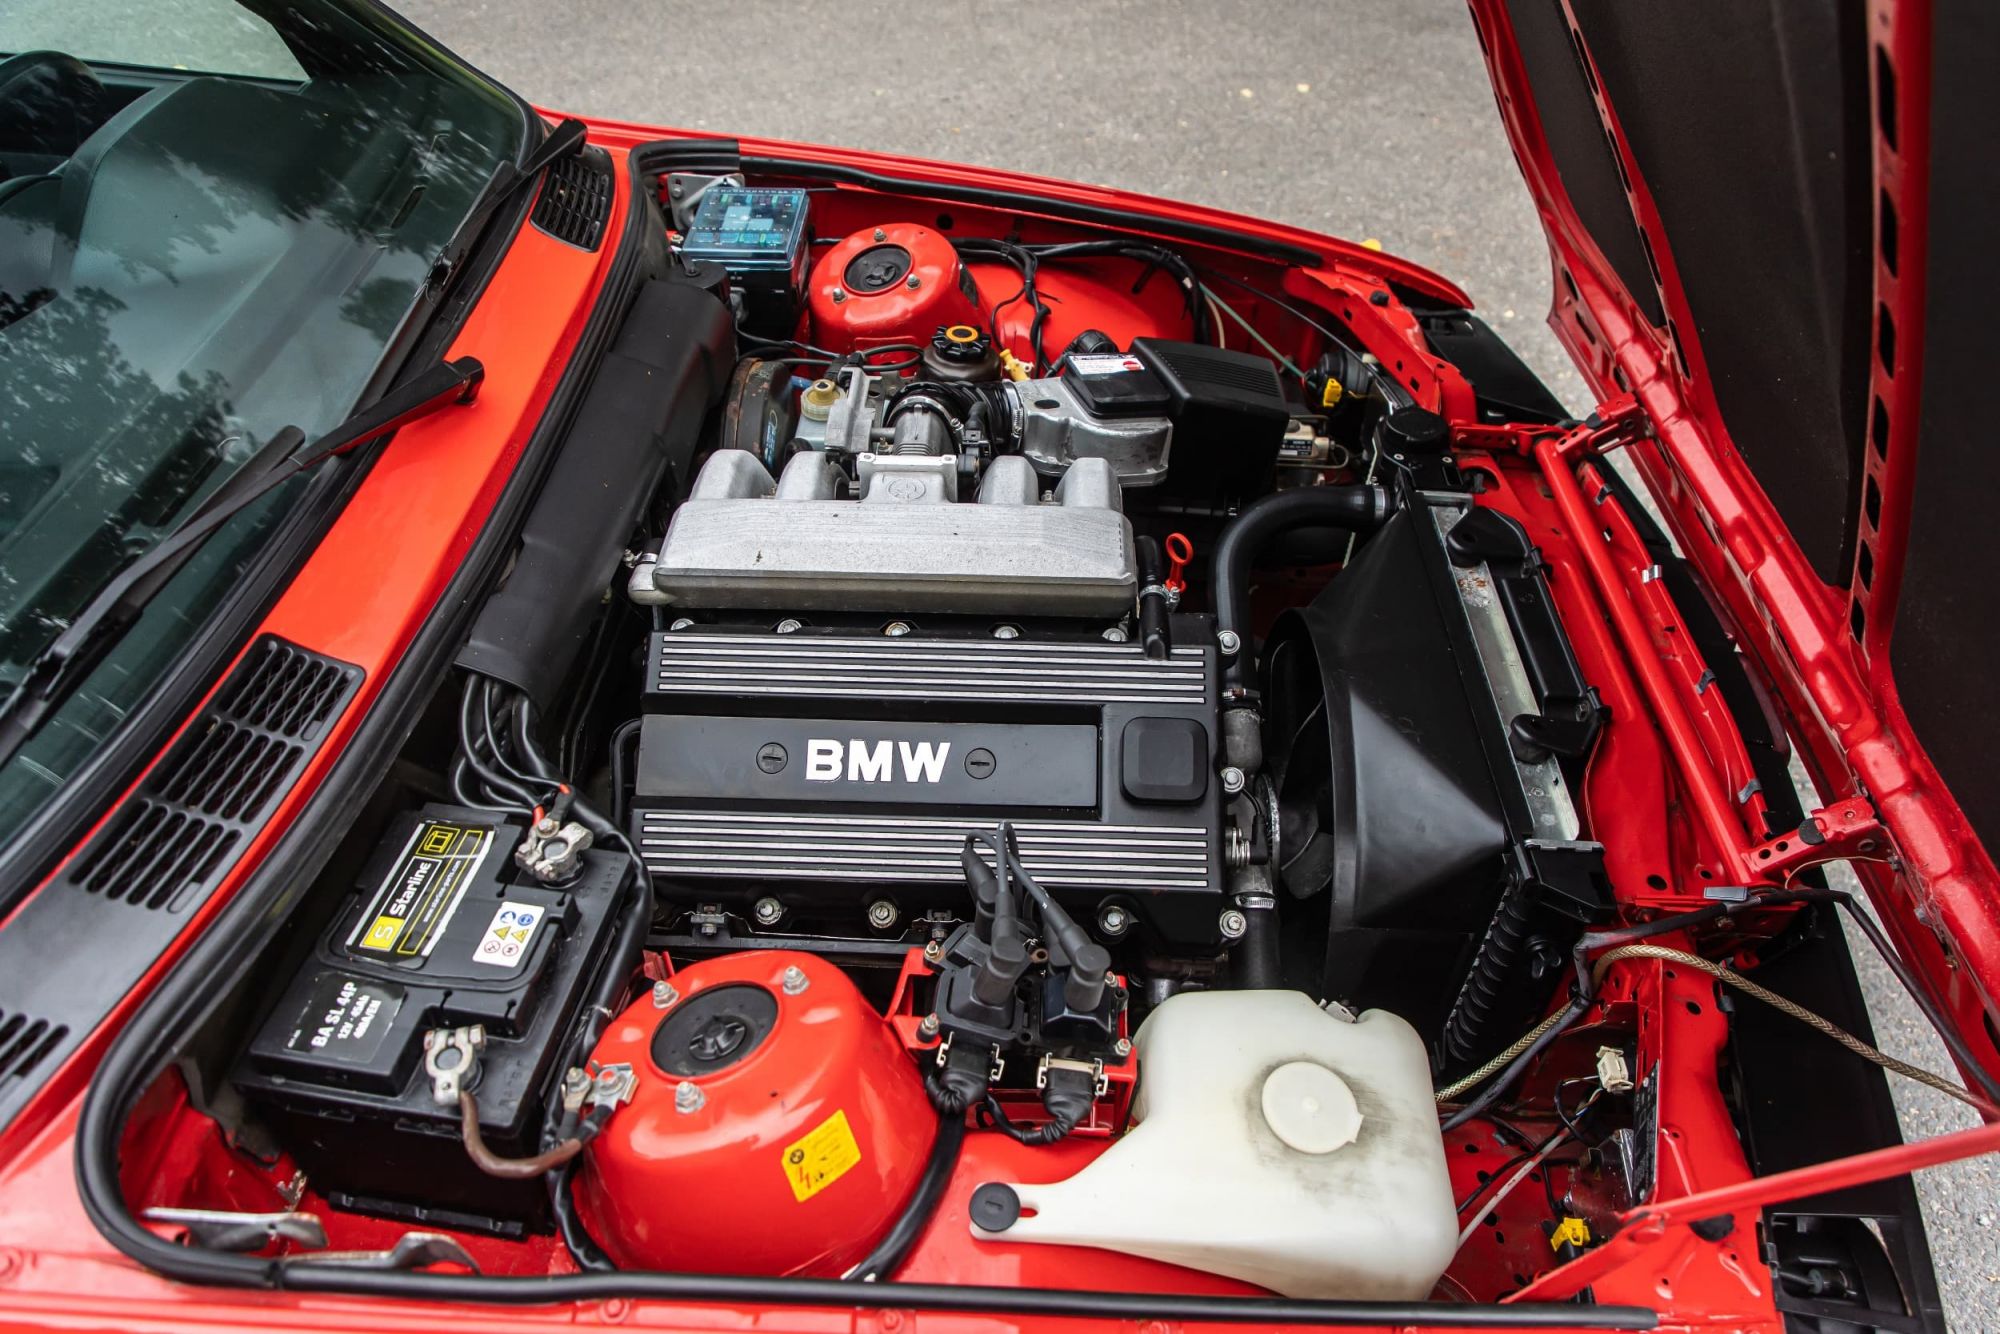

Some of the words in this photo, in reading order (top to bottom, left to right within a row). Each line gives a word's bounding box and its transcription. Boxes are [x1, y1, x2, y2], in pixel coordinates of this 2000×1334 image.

[805, 738, 951, 783] BMW
[390, 862, 432, 916] Starline
[311, 1024, 335, 1048] BA
[325, 1007, 346, 1025] SL
[336, 981, 358, 1008] 44P
[337, 1022, 354, 1040] 12V
